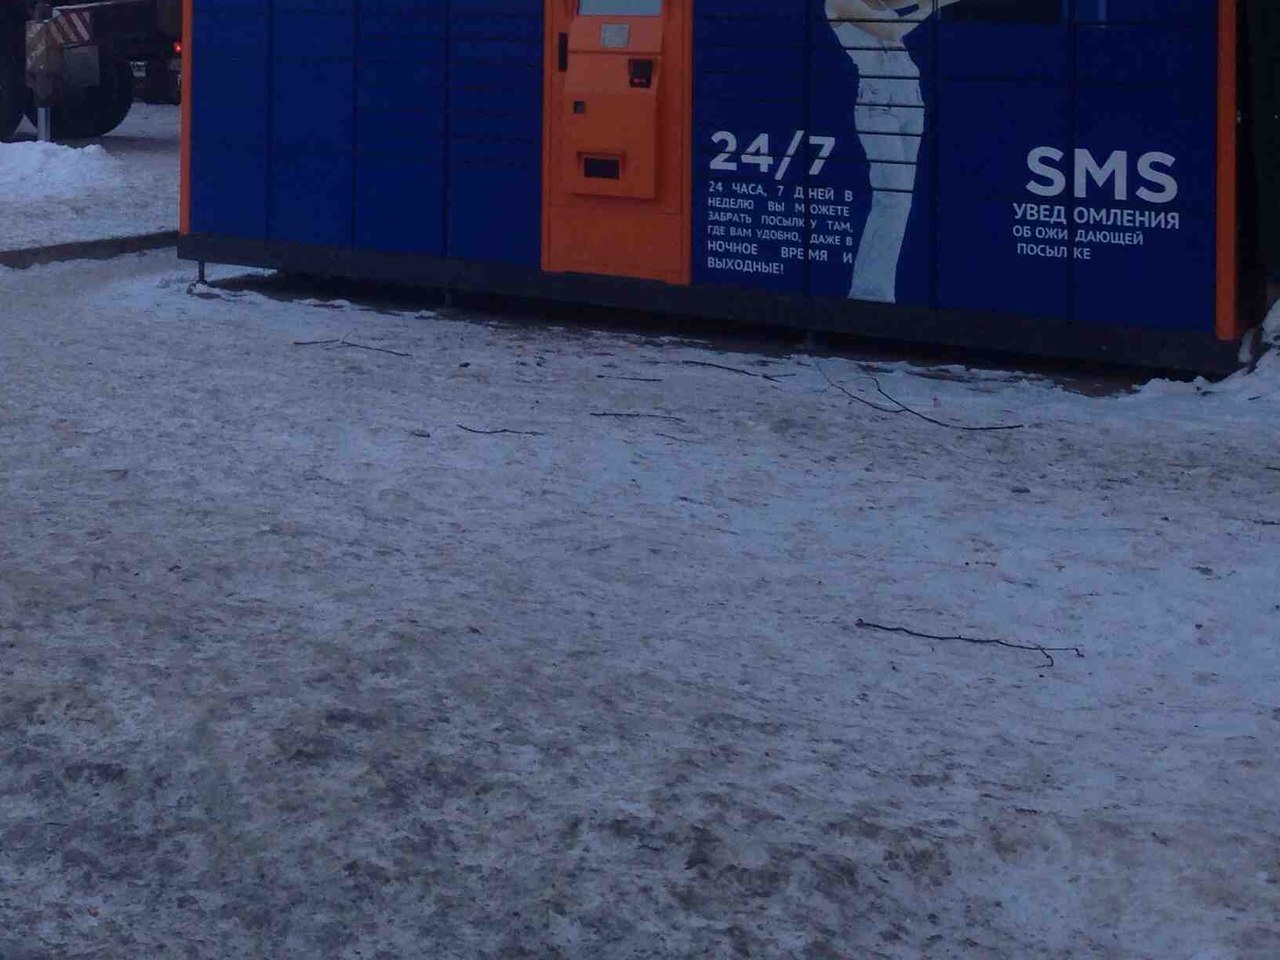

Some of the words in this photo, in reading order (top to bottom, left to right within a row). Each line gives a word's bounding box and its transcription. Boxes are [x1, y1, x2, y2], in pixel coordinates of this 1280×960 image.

[709, 130, 836, 180] 24/7
[1025, 146, 1178, 203] SMS
[708, 181, 723, 192] 24
[732, 183, 767, 197] ЧАСА,
[777, 185, 784, 196] 7
[845, 190, 853, 201] В
[708, 197, 754, 210] НЕДЕЛЮ
[768, 201, 785, 212] ВЫ
[708, 212, 752, 224] ЗАБРАТЬ
[826, 221, 853, 233] ТАМ,
[1012, 226, 1032, 238] ОБ
[708, 226, 726, 237] ГДЕ
[729, 227, 752, 238] ВАМ
[756, 229, 802, 243] УДОБНО,
[810, 234, 841, 246] ДАЖЕ
[845, 236, 853, 246] В
[707, 241, 759, 255] НОЧНОЕ
[843, 253, 852, 264] И
[707, 257, 784, 275] ВЫХОДНЫЕ!
